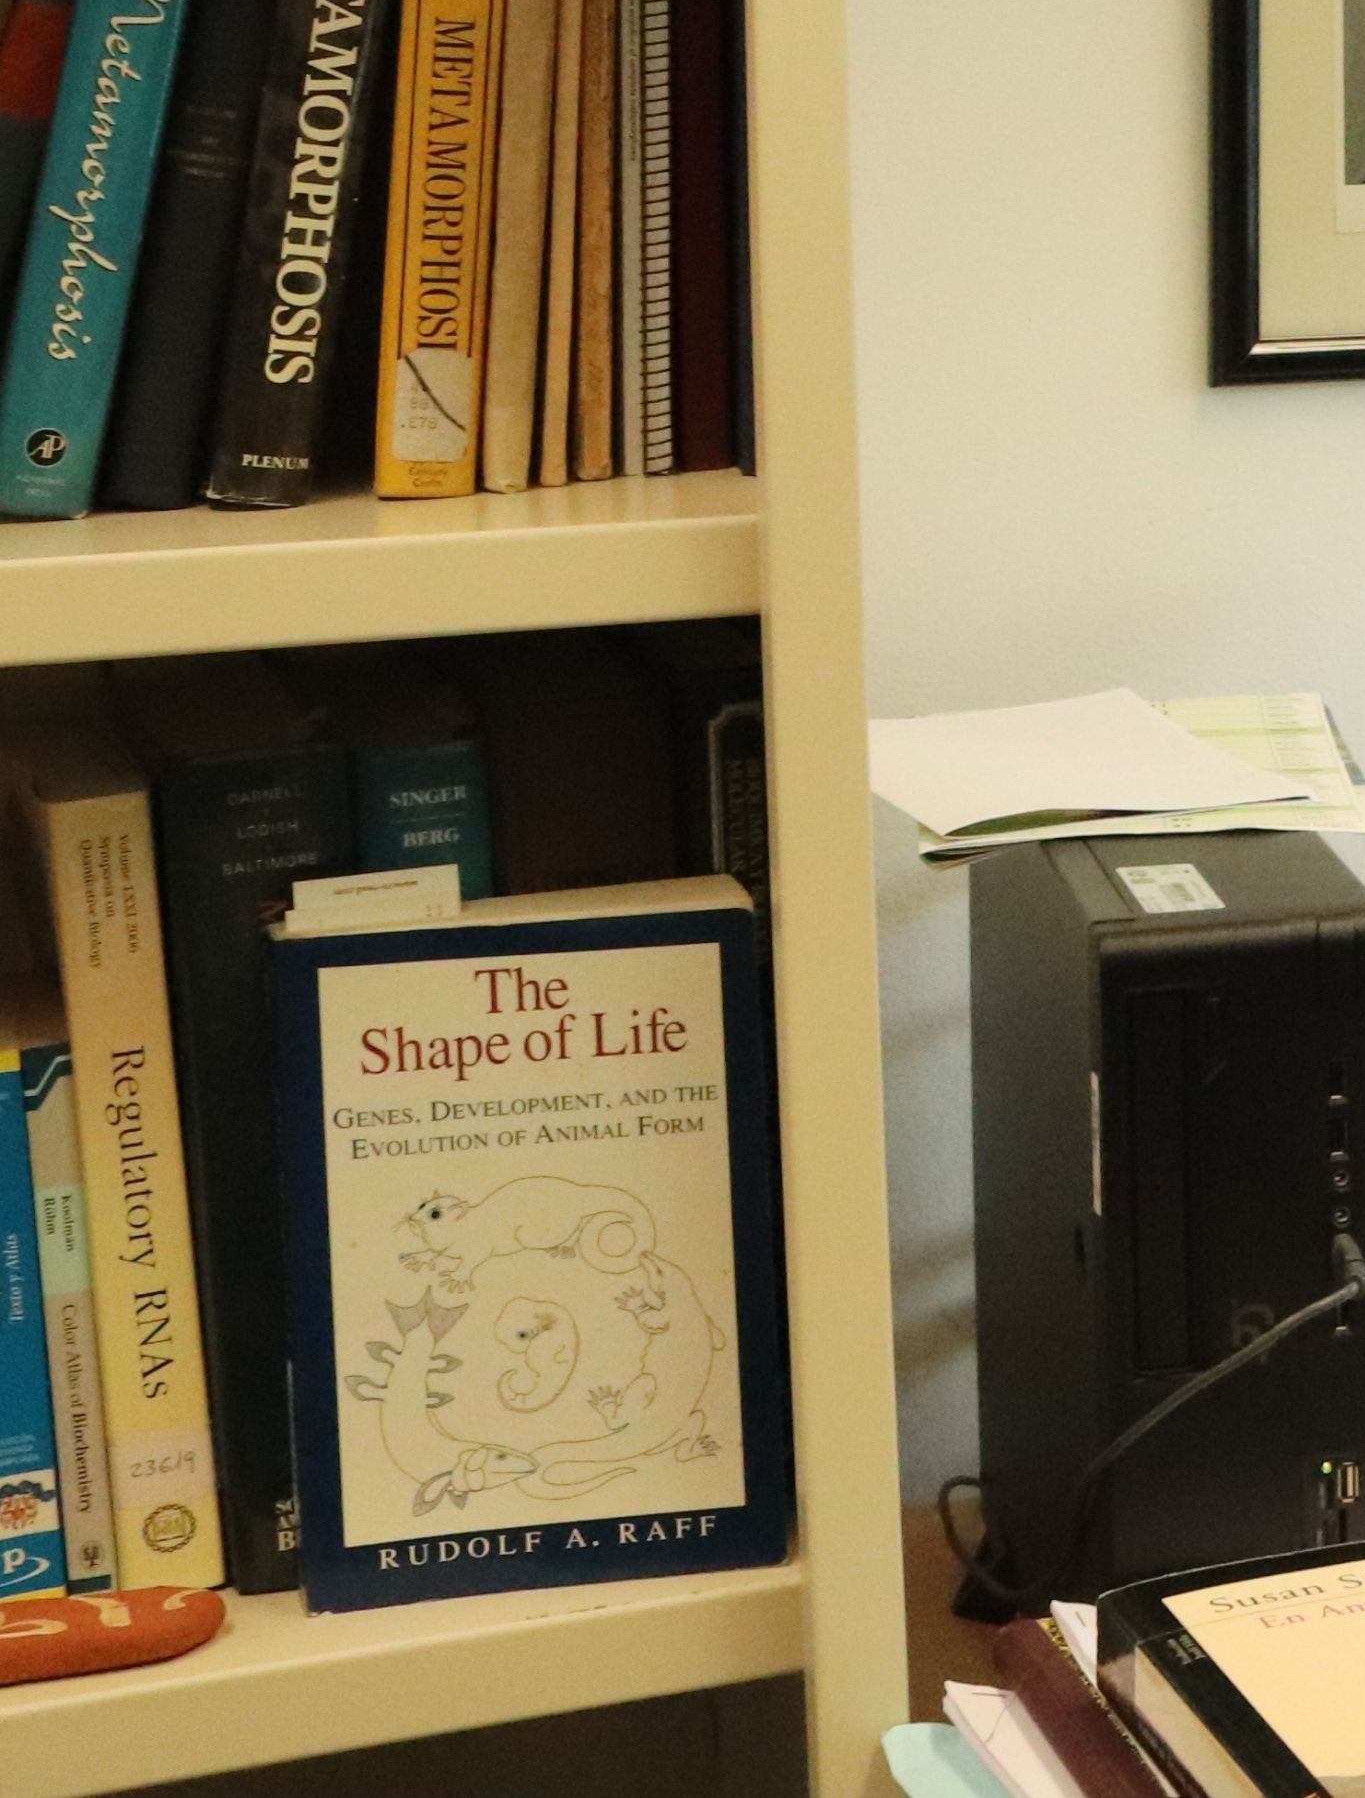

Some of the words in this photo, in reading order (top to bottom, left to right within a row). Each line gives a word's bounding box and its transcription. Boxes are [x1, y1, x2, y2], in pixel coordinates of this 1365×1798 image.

[416, 18, 476, 352] METAMORPHOSI
[241, 452, 310, 471] PLENUM
[389, 785, 467, 808] SINGER
[236, 820, 299, 840] LODISH
[404, 827, 459, 848] BERG
[222, 853, 318, 876] BALTIMORE
[474, 966, 570, 1014] The
[361, 1026, 512, 1081] Shape
[523, 1013, 577, 1062] of
[592, 1006, 689, 1058] Life
[618, 1088, 667, 1107] AND
[674, 1084, 719, 1103] THE
[351, 1131, 489, 1160] EVOLUTION
[497, 1128, 526, 1147] OF
[534, 1123, 630, 1145] ANIMAL
[637, 1115, 705, 1138] FORM
[104, 1045, 158, 1269] Regulatory
[4, 1233, 20, 1271] Atlas
[61, 1303, 77, 1346] Color
[66, 1350, 83, 1392] Atlas
[71, 1394, 84, 1410] of
[72, 1412, 92, 1514] Biochemistry
[378, 1531, 543, 1571] RUDOLF
[565, 1528, 600, 1550] A.
[618, 1515, 718, 1546] RAFF
[1208, 1582, 1325, 1614] Susan
[1258, 1612, 1307, 1630] En
